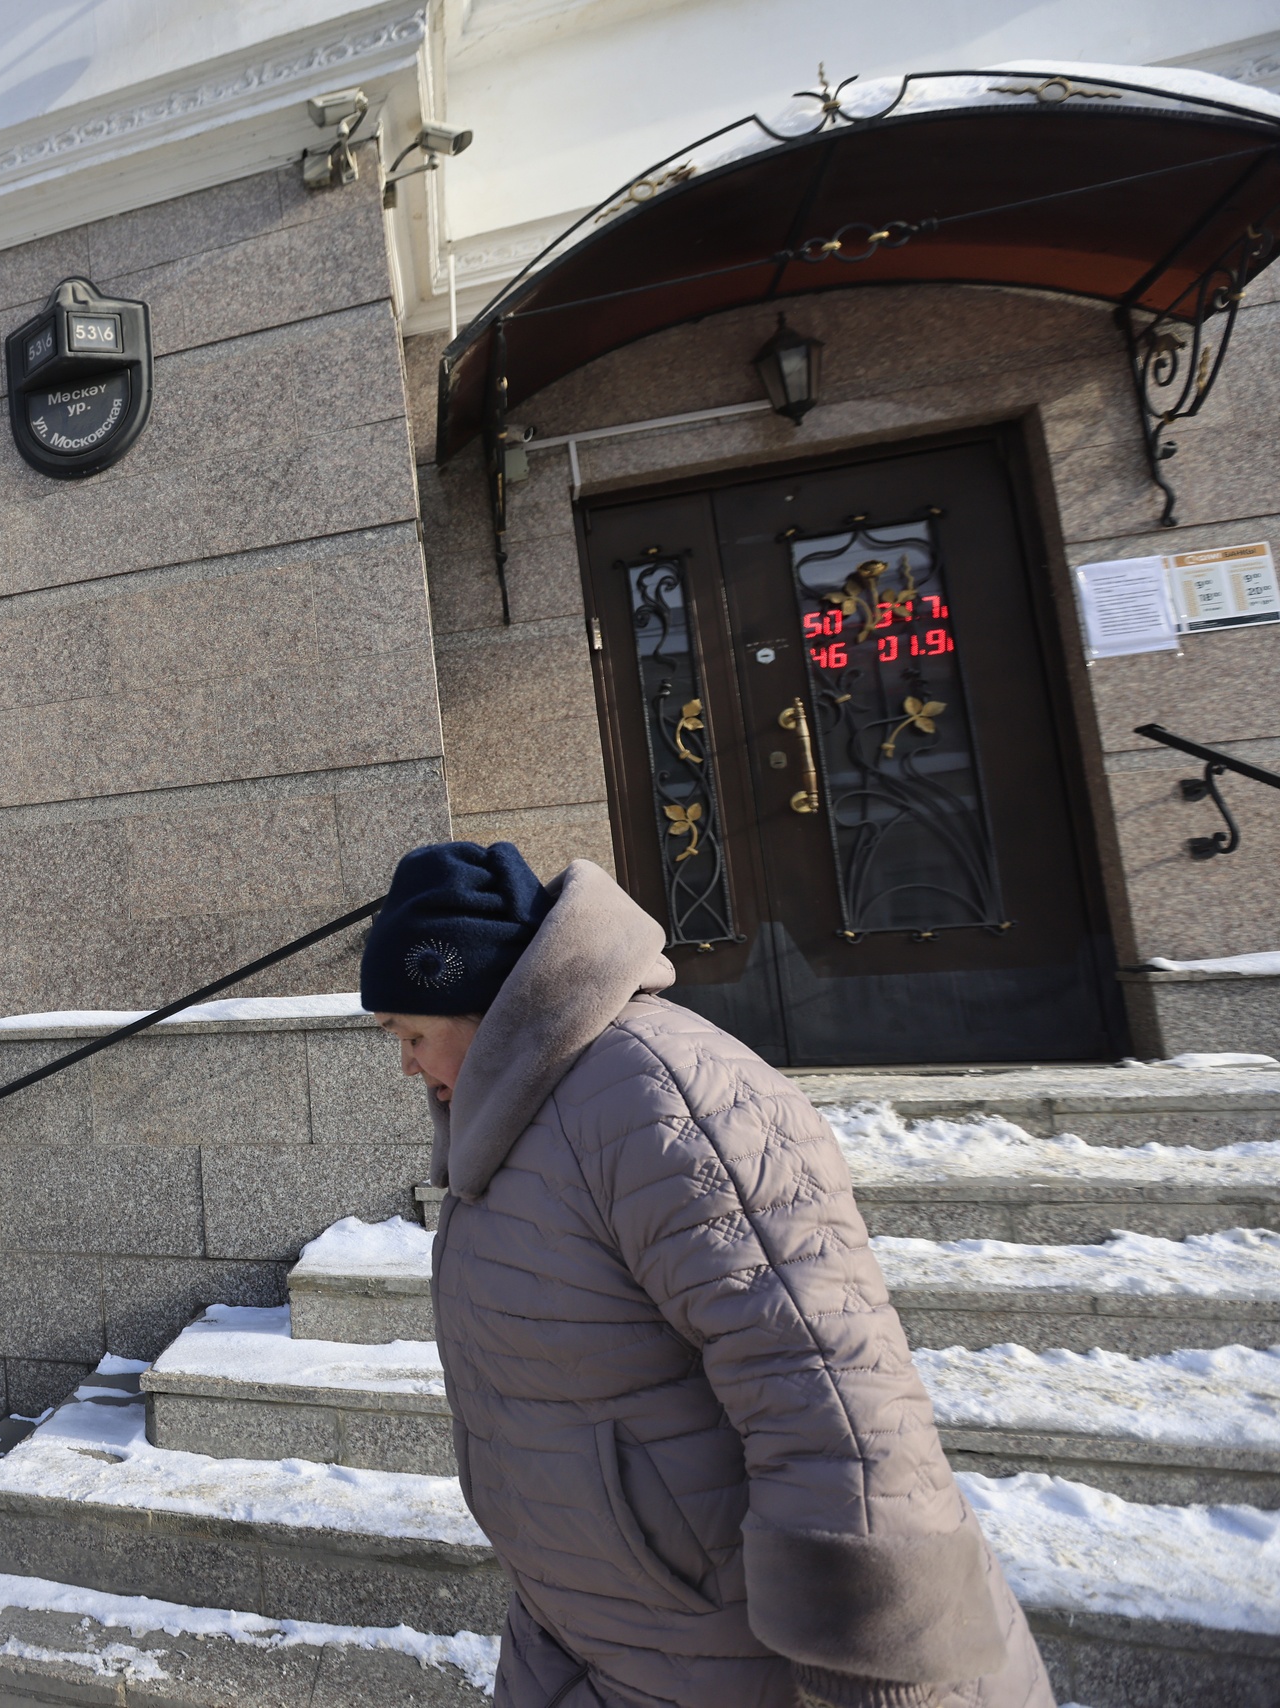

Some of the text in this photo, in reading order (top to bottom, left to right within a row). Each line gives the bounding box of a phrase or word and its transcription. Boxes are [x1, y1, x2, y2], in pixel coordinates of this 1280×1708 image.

[32, 398, 123, 449] ул. Московская
[66, 402, 91, 417] ур.
[803, 608, 843, 639] 50
[809, 641, 849, 669] 46
